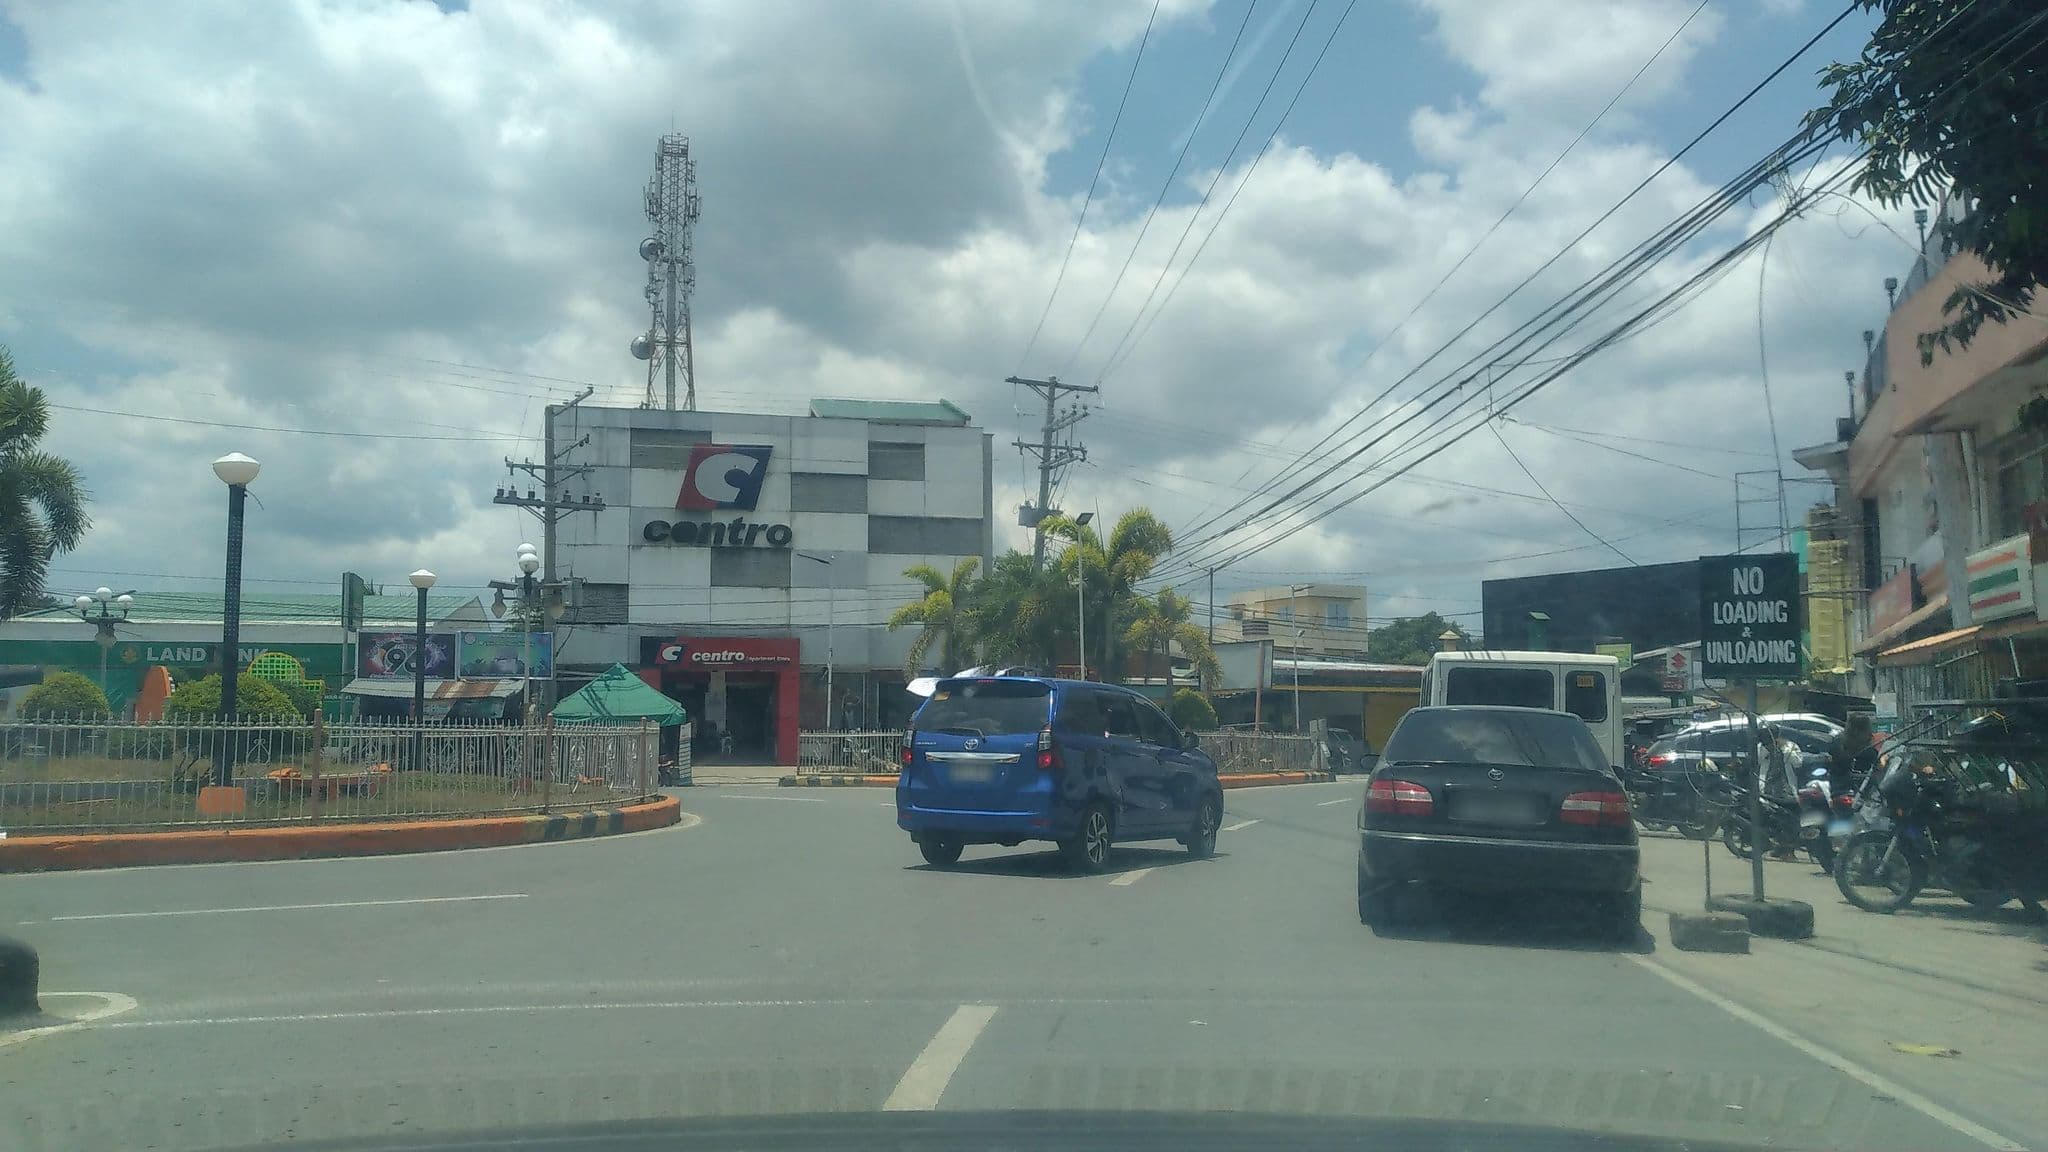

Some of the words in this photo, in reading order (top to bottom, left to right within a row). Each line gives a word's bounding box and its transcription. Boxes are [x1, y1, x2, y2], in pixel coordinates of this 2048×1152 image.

[643, 516, 793, 546] centro
[1733, 566, 1764, 595] NO
[1713, 600, 1788, 624] LOADING
[1742, 626, 1753, 638] &
[146, 647, 207, 662] LAND
[692, 650, 745, 662] centro
[1706, 640, 1796, 664] UNLOADING
